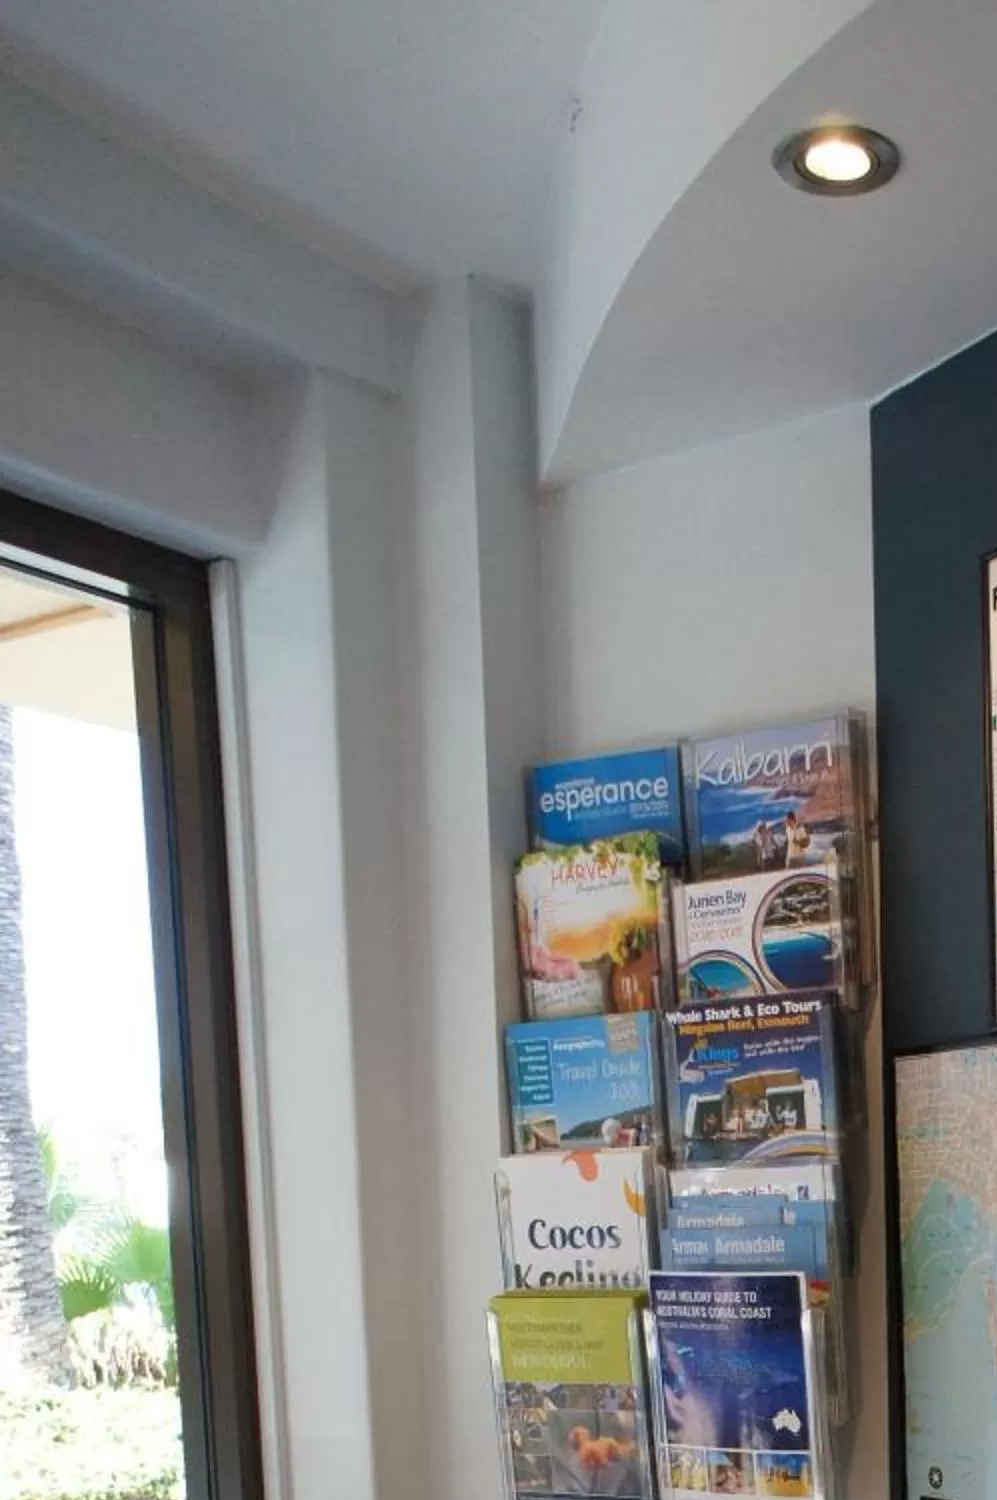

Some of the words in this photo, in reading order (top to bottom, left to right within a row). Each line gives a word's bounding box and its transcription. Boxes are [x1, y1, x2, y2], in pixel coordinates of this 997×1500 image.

[695, 731, 833, 789] Kalbarri
[540, 776, 670, 823] esperance
[725, 889, 747, 909] Bay
[666, 1011, 702, 1025] Whale
[705, 1006, 742, 1021] Shark
[743, 1005, 754, 1017] &
[757, 1003, 780, 1016] Eco
[782, 1000, 823, 1014] Tours
[528, 1218, 622, 1250] Cocos
[744, 1291, 757, 1304] TO
[741, 1307, 772, 1319] COAST
